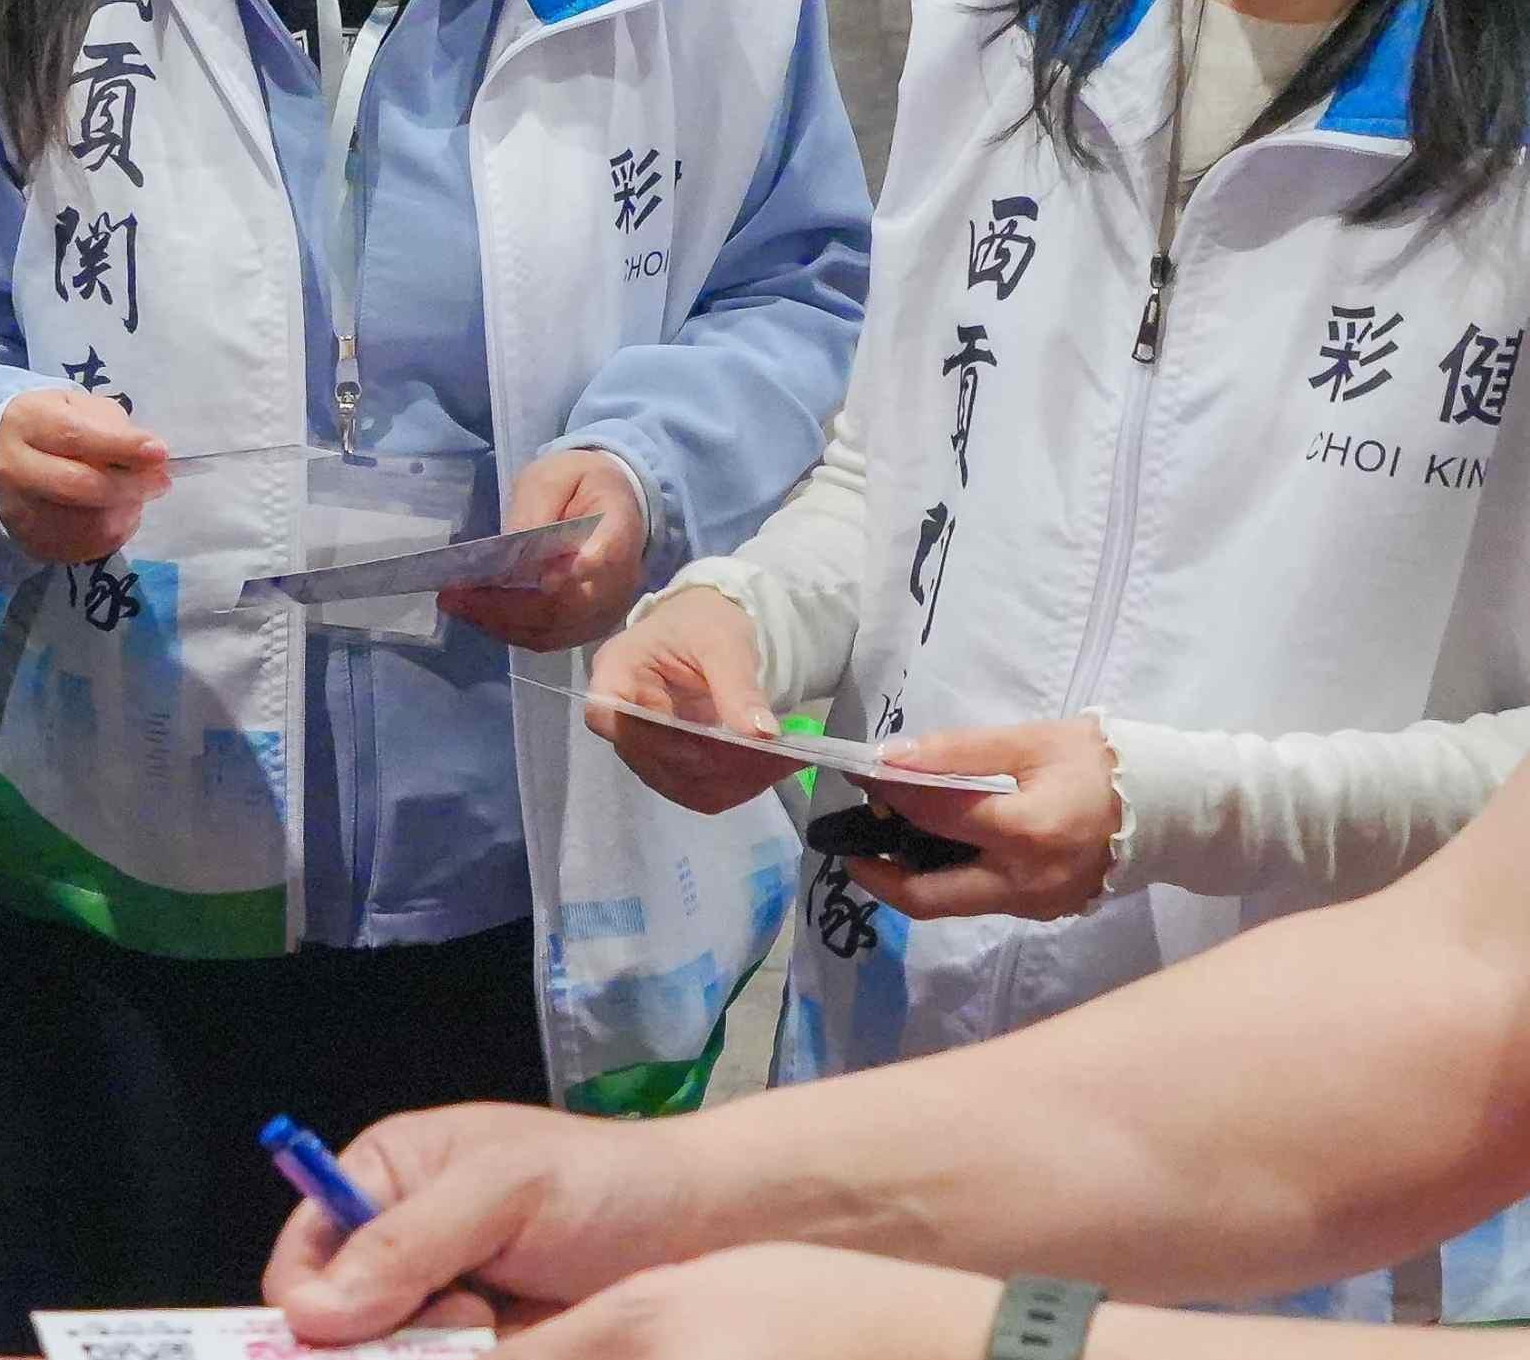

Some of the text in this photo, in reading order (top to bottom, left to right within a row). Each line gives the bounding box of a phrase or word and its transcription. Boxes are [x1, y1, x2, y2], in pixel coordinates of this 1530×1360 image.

[623, 248, 671, 282] HOI
[1307, 305, 1526, 427] 彩健
[1305, 431, 1402, 478] CHOI
